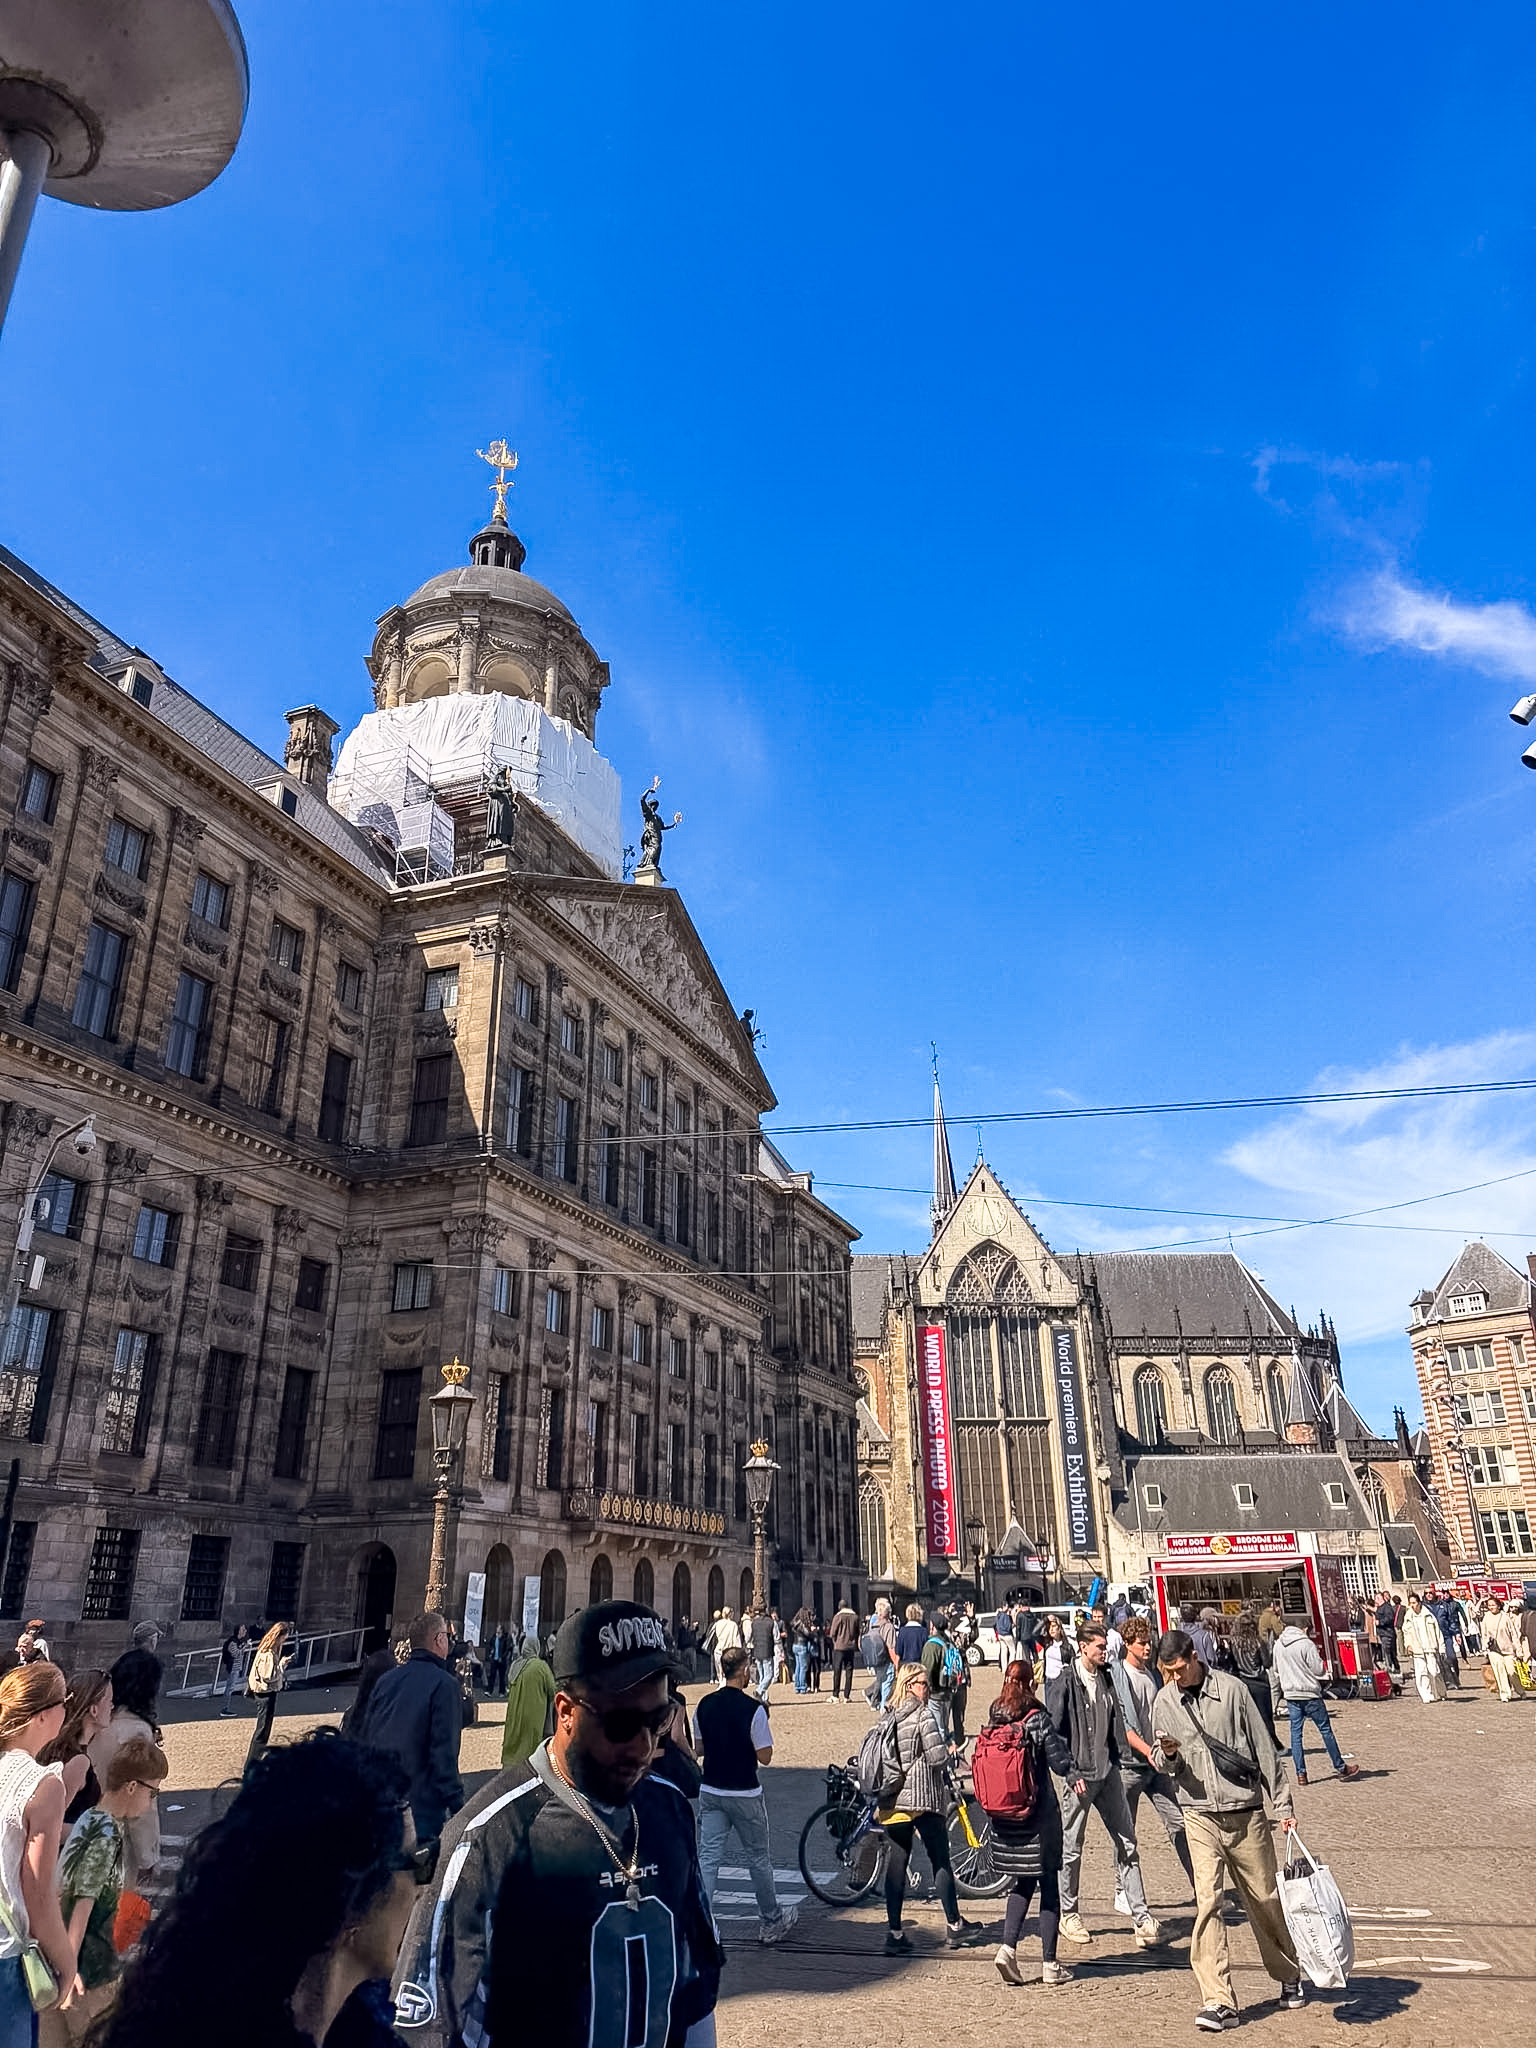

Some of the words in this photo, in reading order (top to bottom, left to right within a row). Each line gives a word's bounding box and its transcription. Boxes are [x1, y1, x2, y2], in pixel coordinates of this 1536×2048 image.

[924, 1333, 941, 1387] WORLD
[1057, 1333, 1074, 1375] World
[927, 1389, 945, 1435] PRESS
[1058, 1379, 1079, 1445] premiere
[929, 1438, 948, 1490] PHOTO
[1066, 1453, 1089, 1545] Exhibition
[932, 1499, 951, 1547] 2026
[1172, 1538, 1187, 1547] HOT
[1188, 1537, 1206, 1546] DOG
[1236, 1535, 1272, 1545] BROODJE
[1272, 1534, 1288, 1543] BAL
[1168, 1546, 1212, 1555] HAMBURGER
[1231, 1545, 1259, 1553] WARME
[1259, 1543, 1296, 1552] BEENHAM
